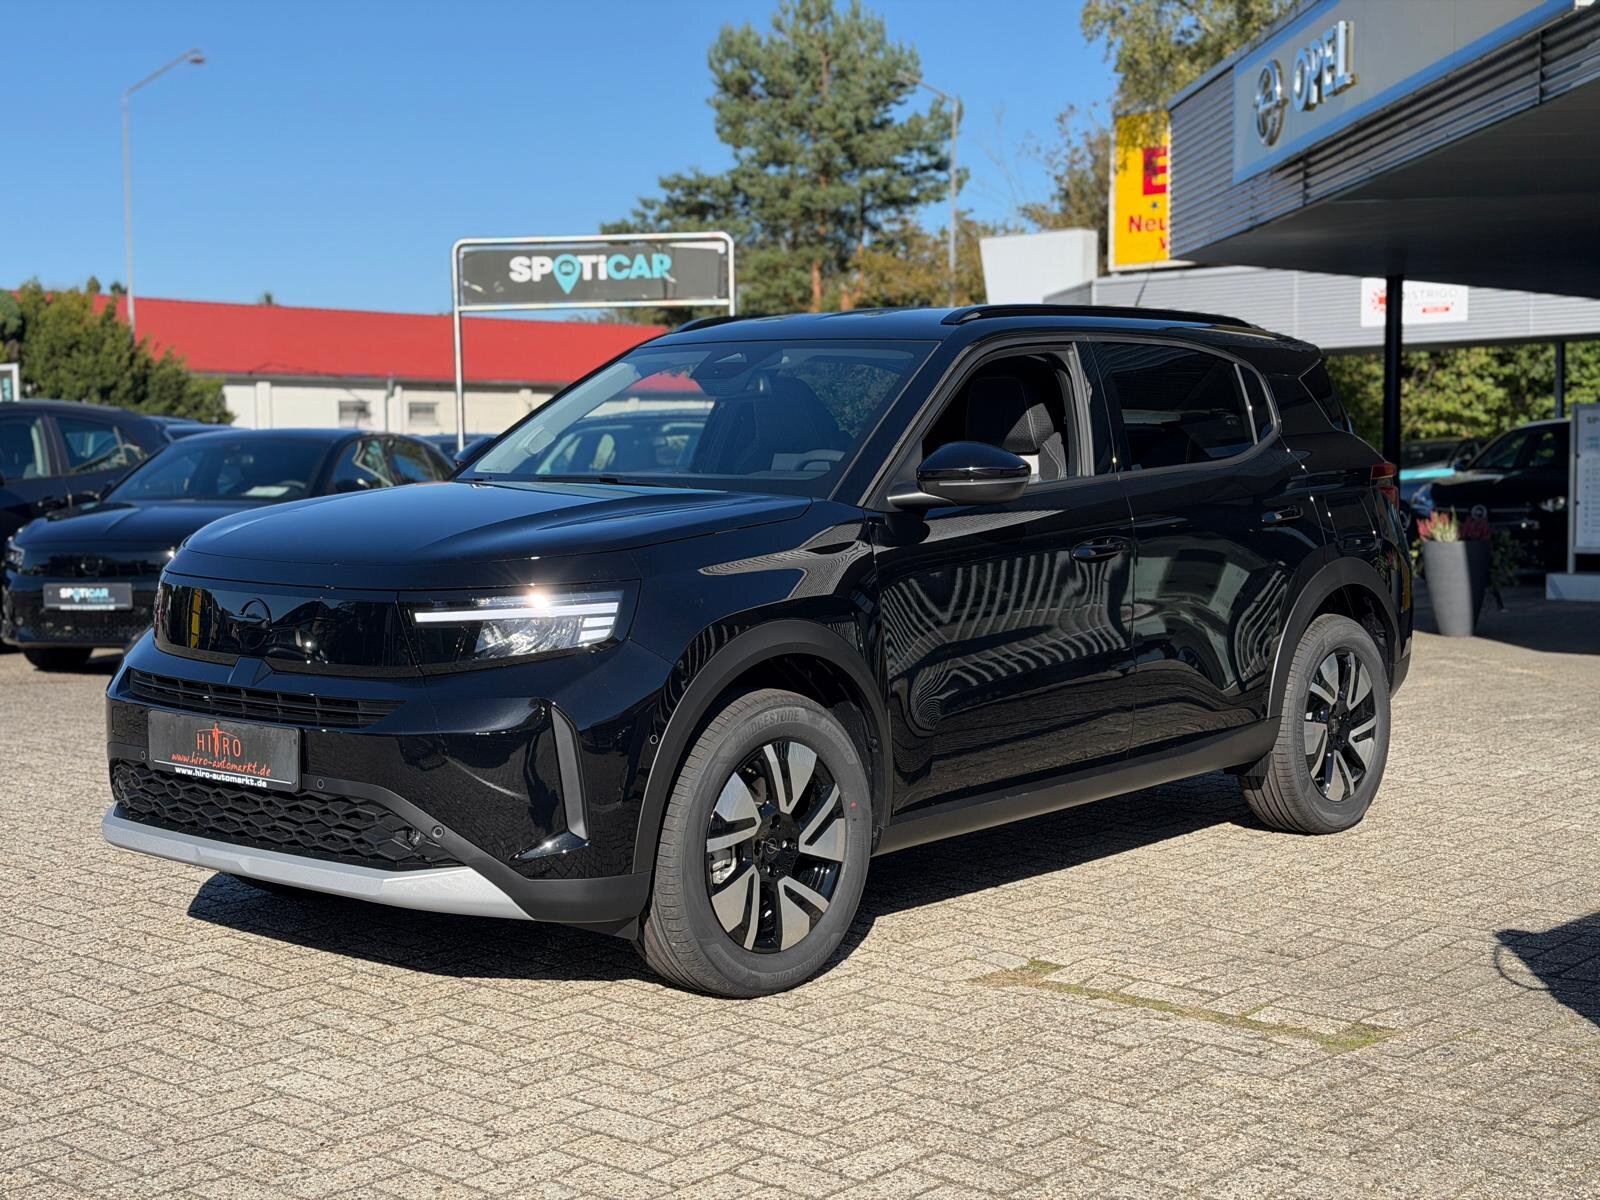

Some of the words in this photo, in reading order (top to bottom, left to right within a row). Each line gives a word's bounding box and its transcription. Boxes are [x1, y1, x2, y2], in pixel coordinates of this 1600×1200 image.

[1292, 20, 1357, 112] OPEL
[171, 752, 273, 777] www.hiro-automarkt.de
[174, 766, 268, 788] www.hiro-automarkt.de
